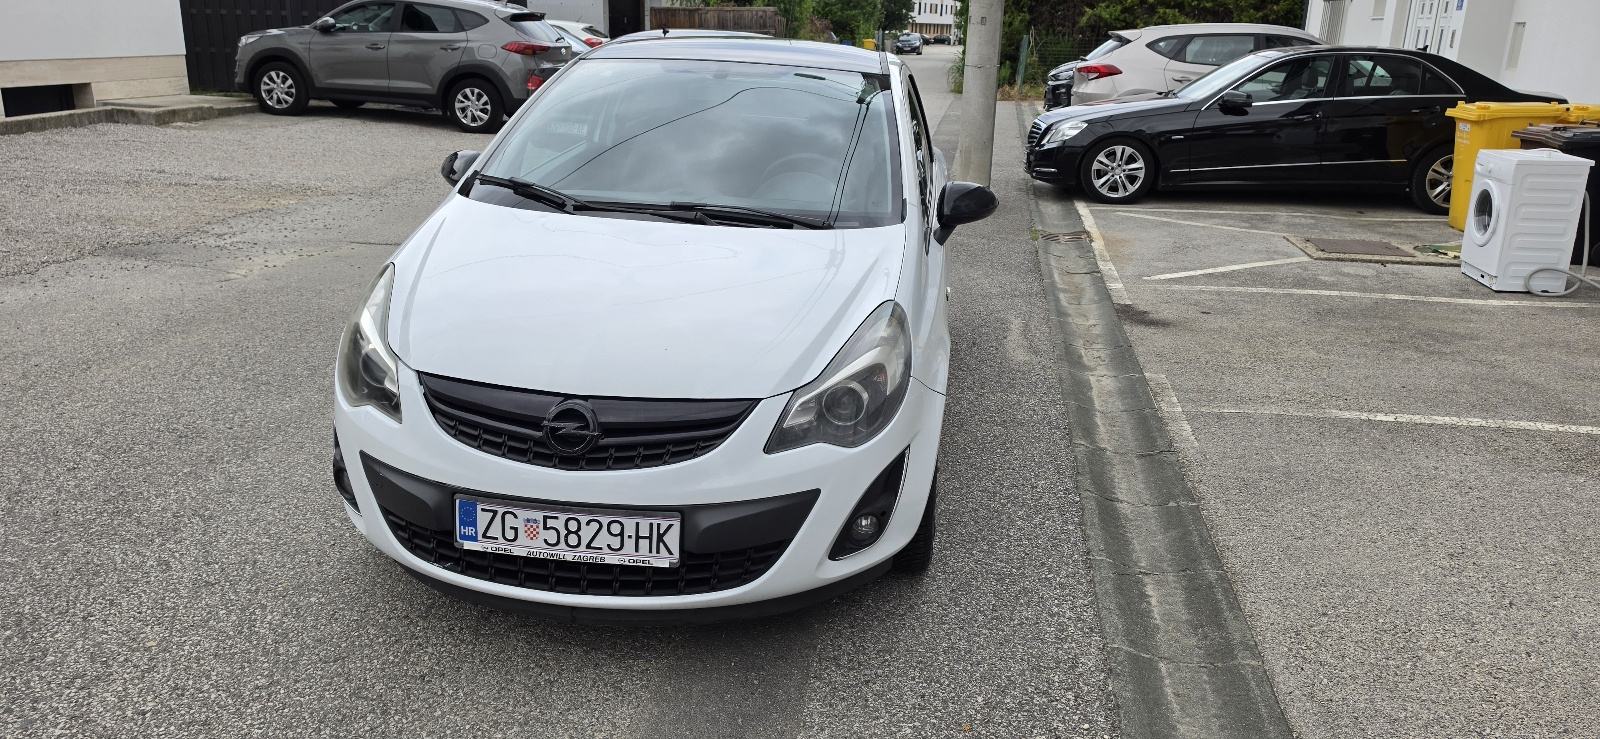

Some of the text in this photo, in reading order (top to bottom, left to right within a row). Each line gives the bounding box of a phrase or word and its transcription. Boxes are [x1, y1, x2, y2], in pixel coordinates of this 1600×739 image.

[460, 525, 476, 537] HR
[480, 507, 519, 543] ZG
[490, 546, 515, 554] OPEL
[526, 550, 606, 563] AUTOWILL ZAGREB
[628, 558, 654, 566] OPEL
